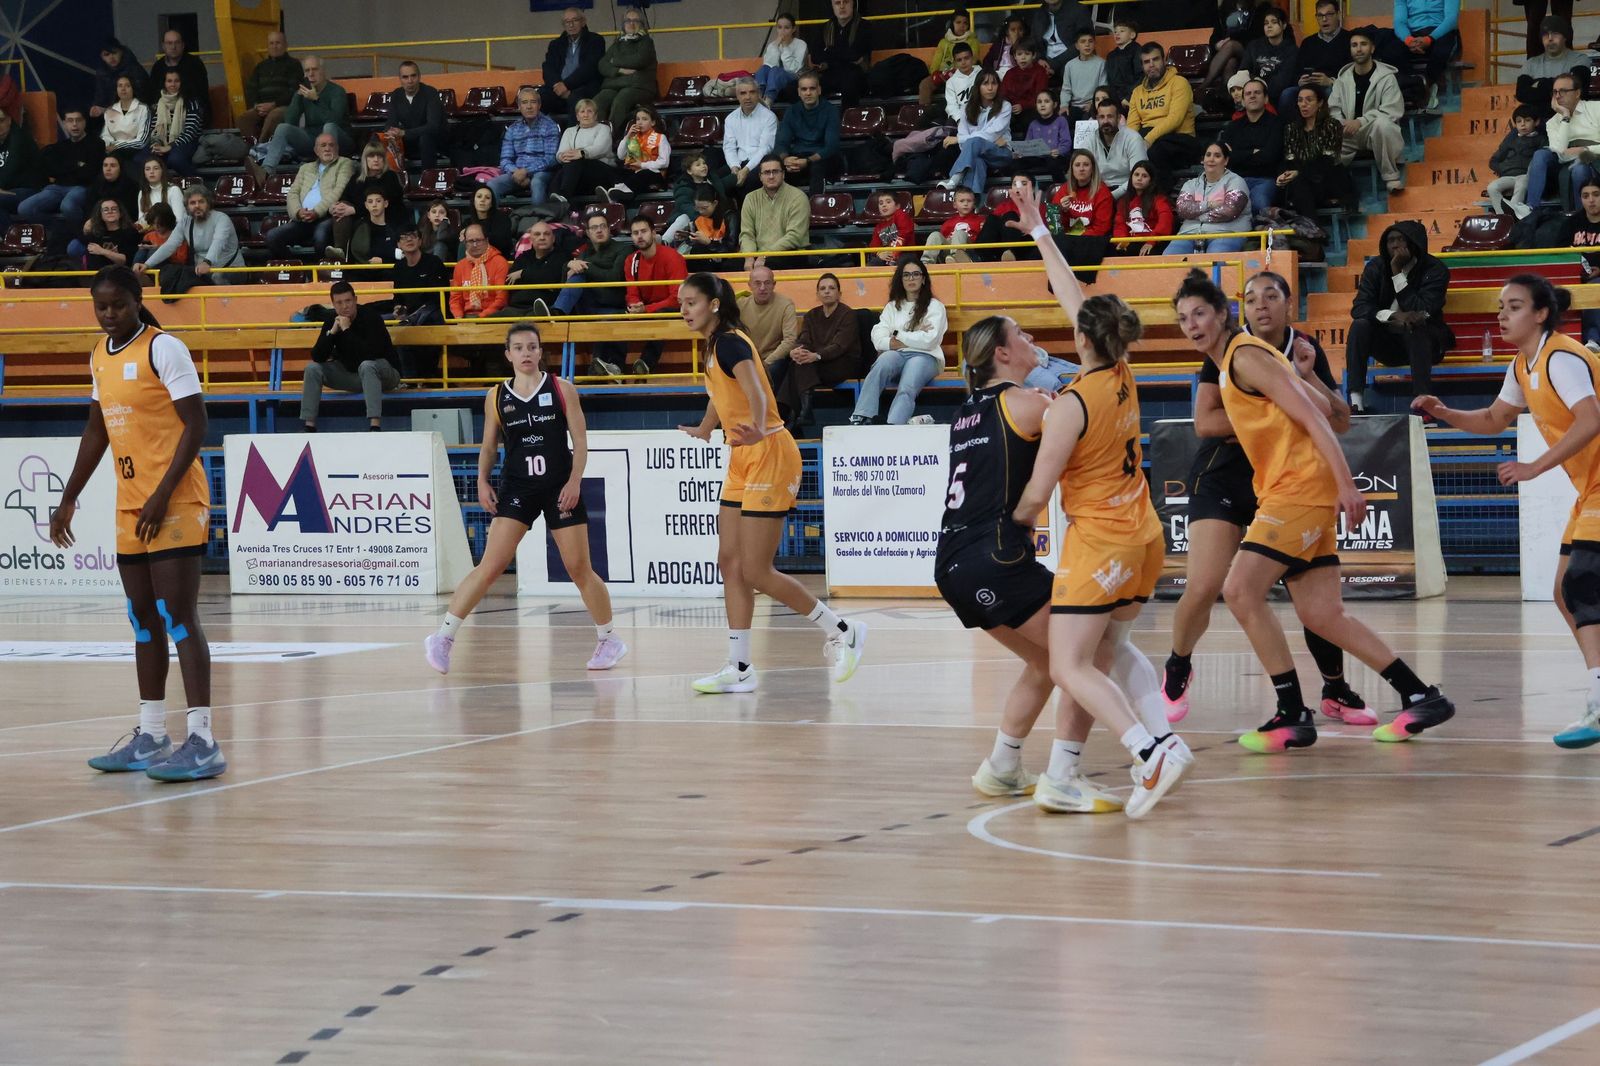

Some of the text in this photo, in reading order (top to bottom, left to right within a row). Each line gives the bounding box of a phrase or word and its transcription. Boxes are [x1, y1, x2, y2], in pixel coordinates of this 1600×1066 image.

[1184, 48, 1195, 58] 17
[688, 79, 695, 89] 2
[480, 91, 491, 99] 10
[1140, 94, 1165, 110] VANS
[861, 111, 868, 121] 7
[699, 118, 704, 129] 1
[438, 171, 445, 182] 8
[1431, 167, 1479, 186] FILA
[827, 196, 836, 208] 9
[1480, 218, 1499, 230] 27
[646, 447, 722, 469] LUIS FELIPE
[832, 455, 939, 467] E.S. CAMINO DE LA PLATA
[118, 456, 135, 480] 23
[525, 455, 546, 476] 10
[832, 470, 899, 482] Tfno.: 980 570 021
[678, 477, 723, 502] GÓMEZ
[832, 484, 926, 496] Morales del Vino (Zamora)
[944, 462, 967, 510] 5
[834, 532, 874, 542] SERVICIO
[876, 532, 883, 541] A
[885, 531, 929, 541] DOMICILIO
[236, 545, 270, 553] Avenida
[272, 545, 291, 553] Tres
[293, 545, 323, 553] Cruces
[325, 545, 334, 553] 17
[336, 545, 354, 553] Entr
[368, 545, 394, 554] 49008
[395, 545, 428, 553] Zamora
[1343, 540, 1394, 550] LIMITES
[74, 546, 118, 570] salu
[836, 548, 862, 557] Gasóleo
[864, 548, 872, 557] de
[873, 547, 909, 557] Calefacción
[910, 550, 914, 559] y
[259, 559, 420, 570] marianandresasesoria@gmail.com
[259, 574, 280, 586] 980
[283, 574, 298, 586] 05
[301, 574, 315, 586] 85
[318, 574, 333, 586] 90
[344, 575, 366, 587] 605
[369, 575, 384, 587] 76
[387, 575, 400, 587] 71
[405, 575, 419, 587] 05
